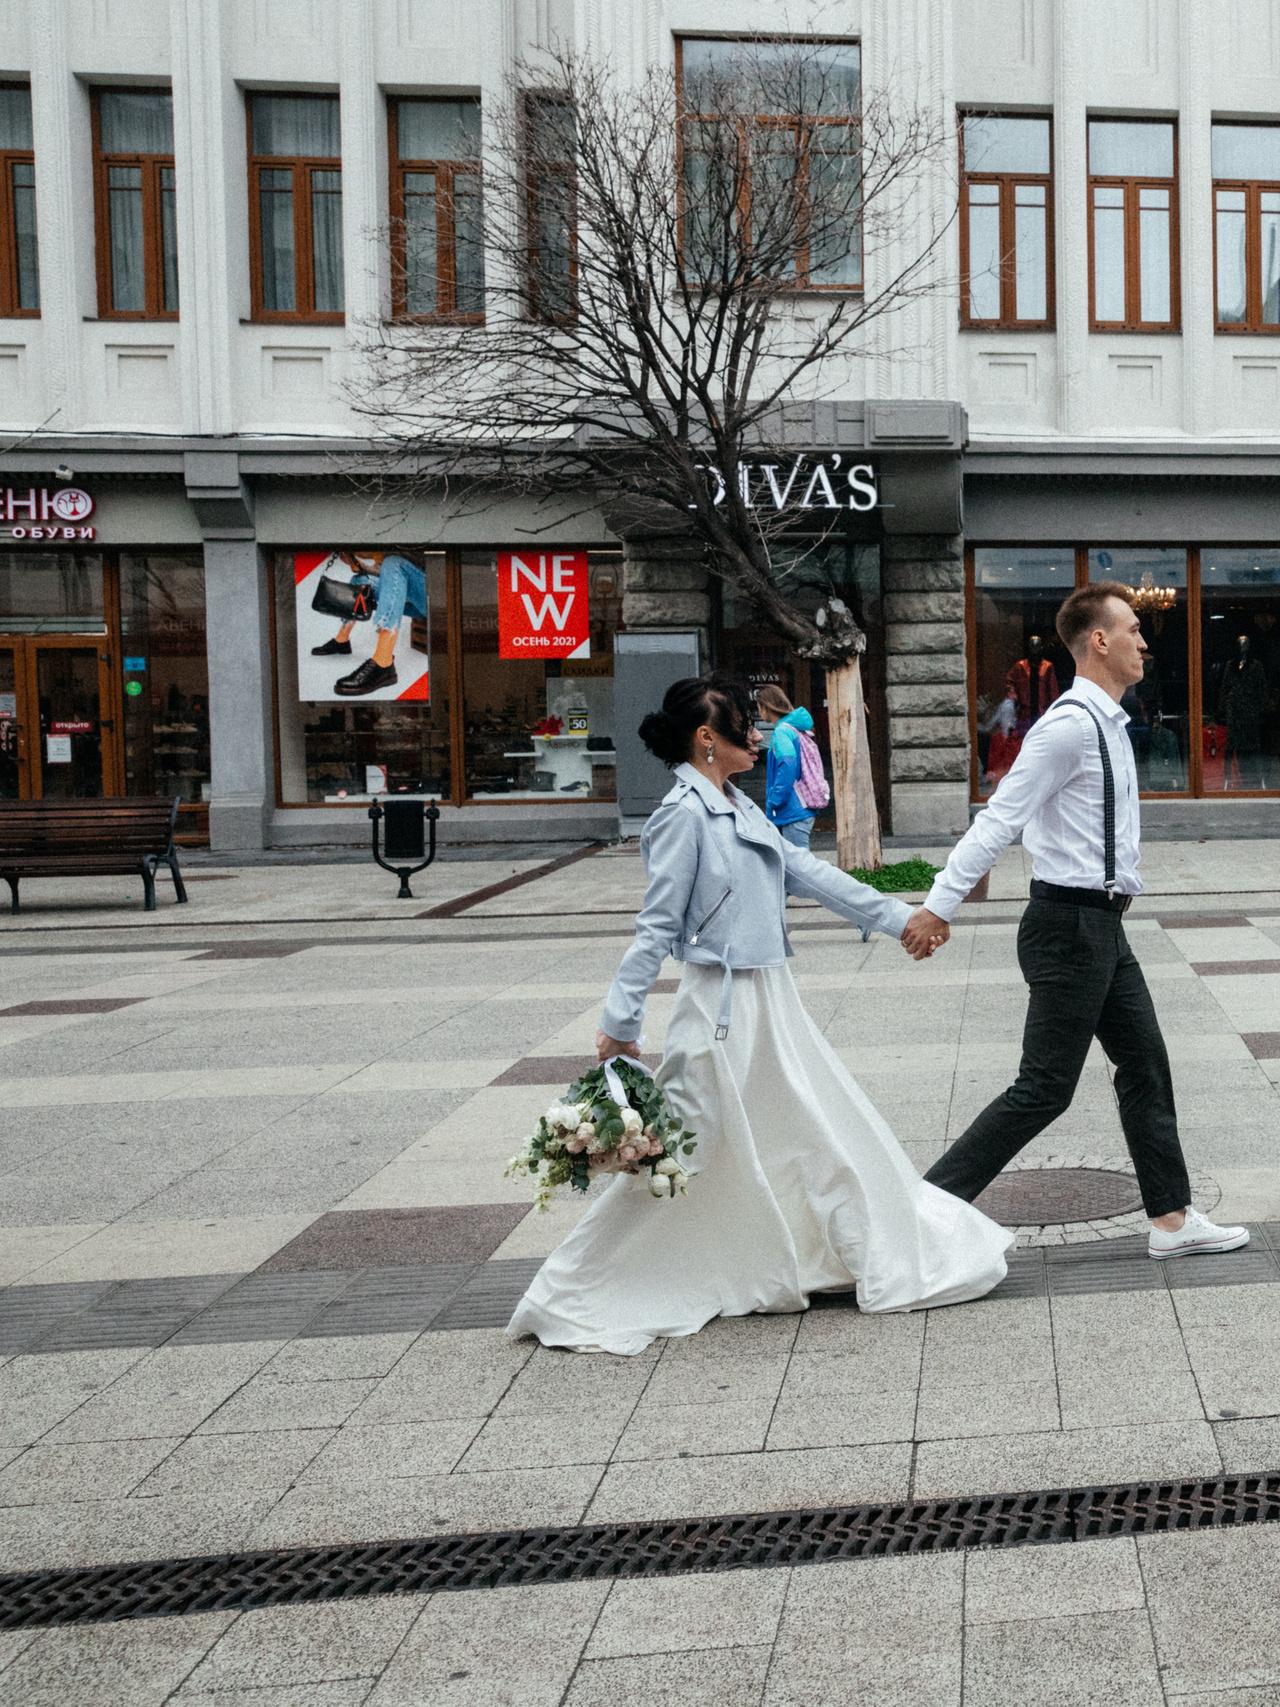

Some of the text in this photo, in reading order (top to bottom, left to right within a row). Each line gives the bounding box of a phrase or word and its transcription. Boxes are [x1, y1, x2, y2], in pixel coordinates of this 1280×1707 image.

[0, 487, 93, 521] НЮ
[12, 526, 94, 539] ОБУВИ
[511, 555, 576, 593] NE
[521, 593, 576, 631] W
[512, 636, 576, 646] ОСЕНЬ 2021
